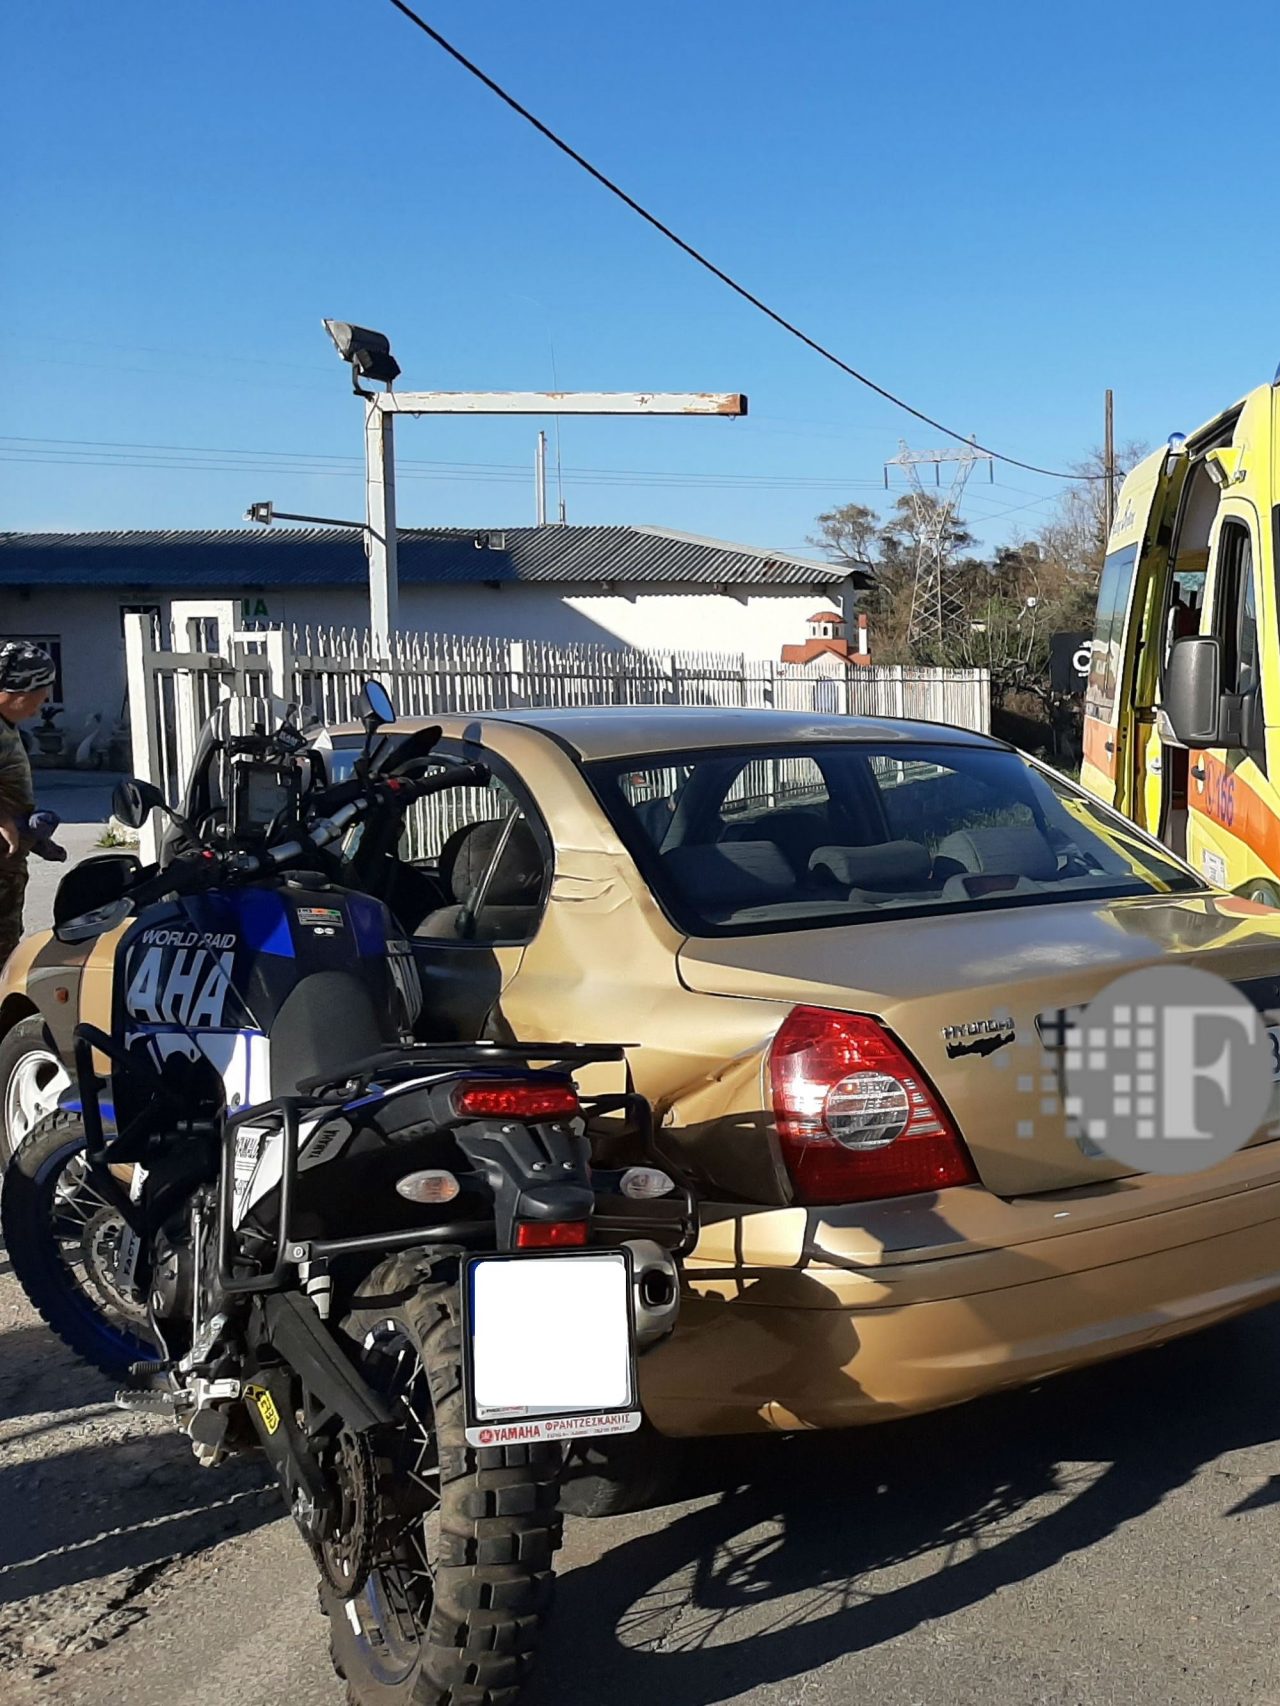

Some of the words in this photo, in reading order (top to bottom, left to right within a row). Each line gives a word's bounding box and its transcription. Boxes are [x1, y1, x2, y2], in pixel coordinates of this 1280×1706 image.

[1216, 772, 1235, 827] 166
[142, 929, 198, 946] WORLD
[197, 933, 236, 948] RAID
[494, 1425, 541, 1442] YAMAHA
